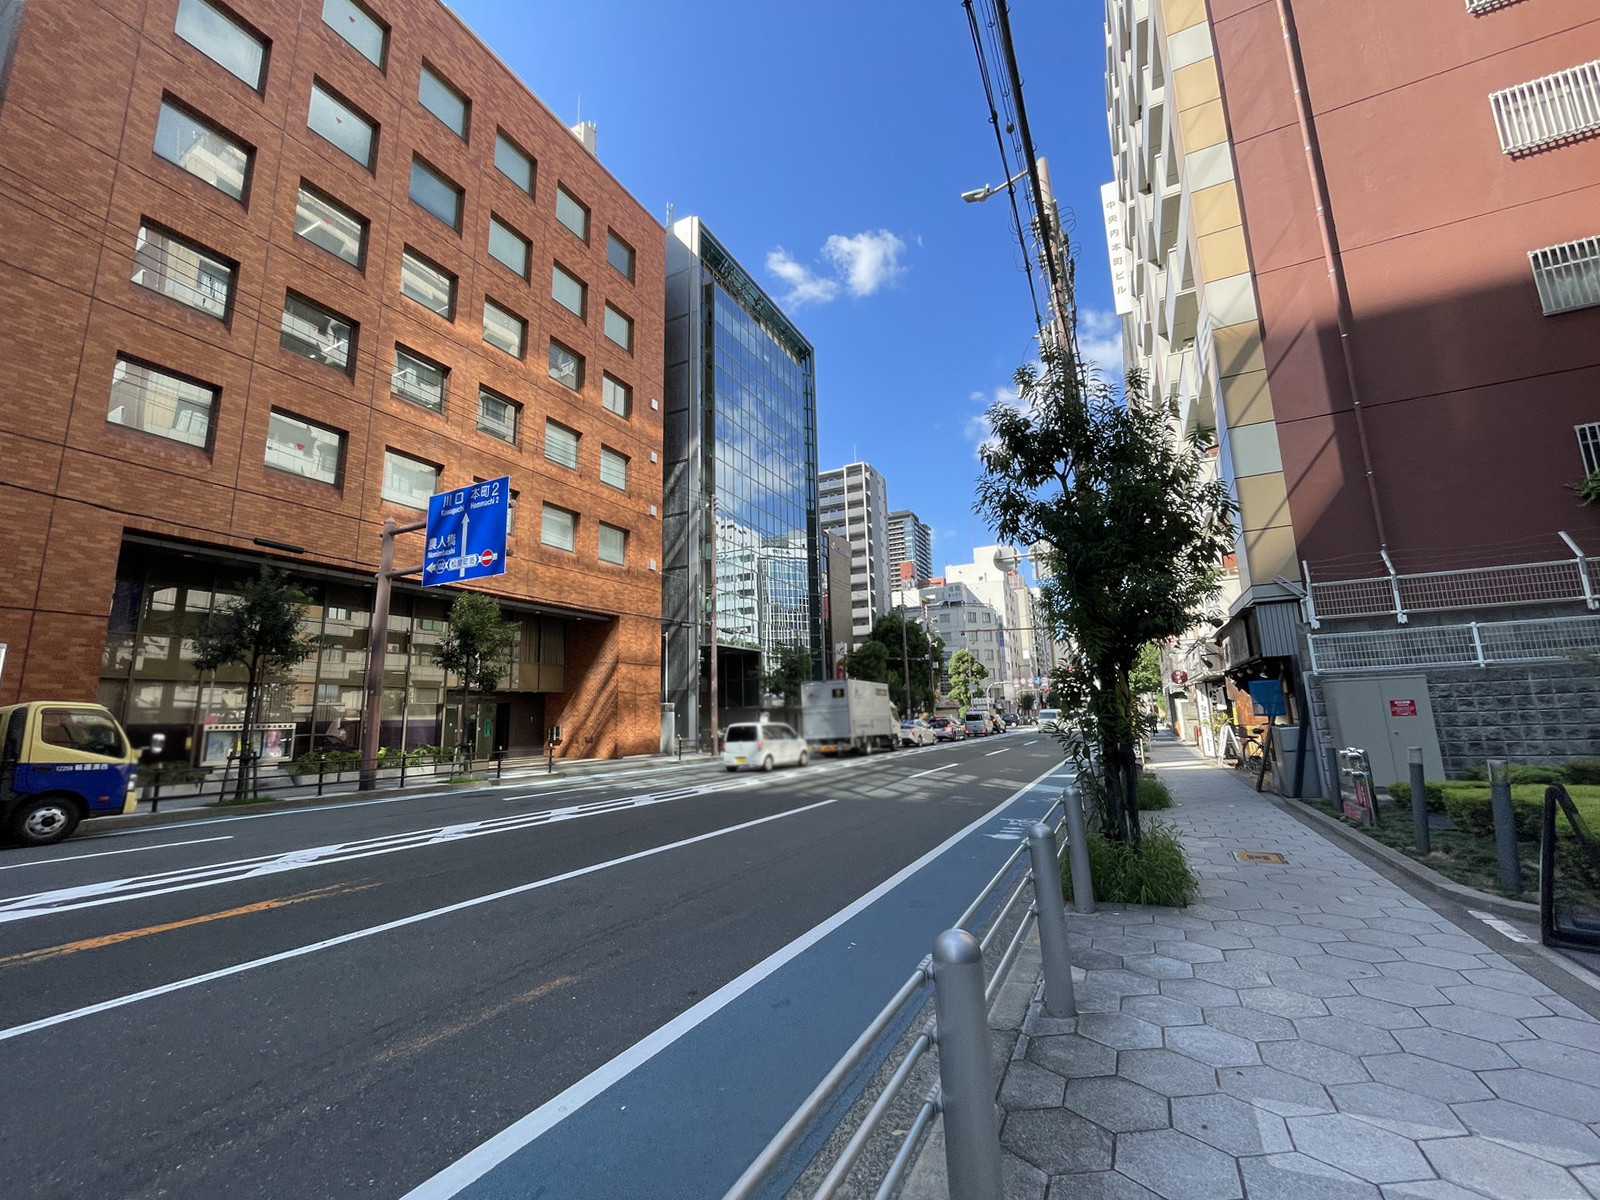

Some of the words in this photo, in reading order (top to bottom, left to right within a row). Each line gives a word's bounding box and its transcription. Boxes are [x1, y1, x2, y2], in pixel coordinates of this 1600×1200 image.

[1106, 201, 1126, 295] 中央内本町ビル
[443, 492, 464, 507] 川口
